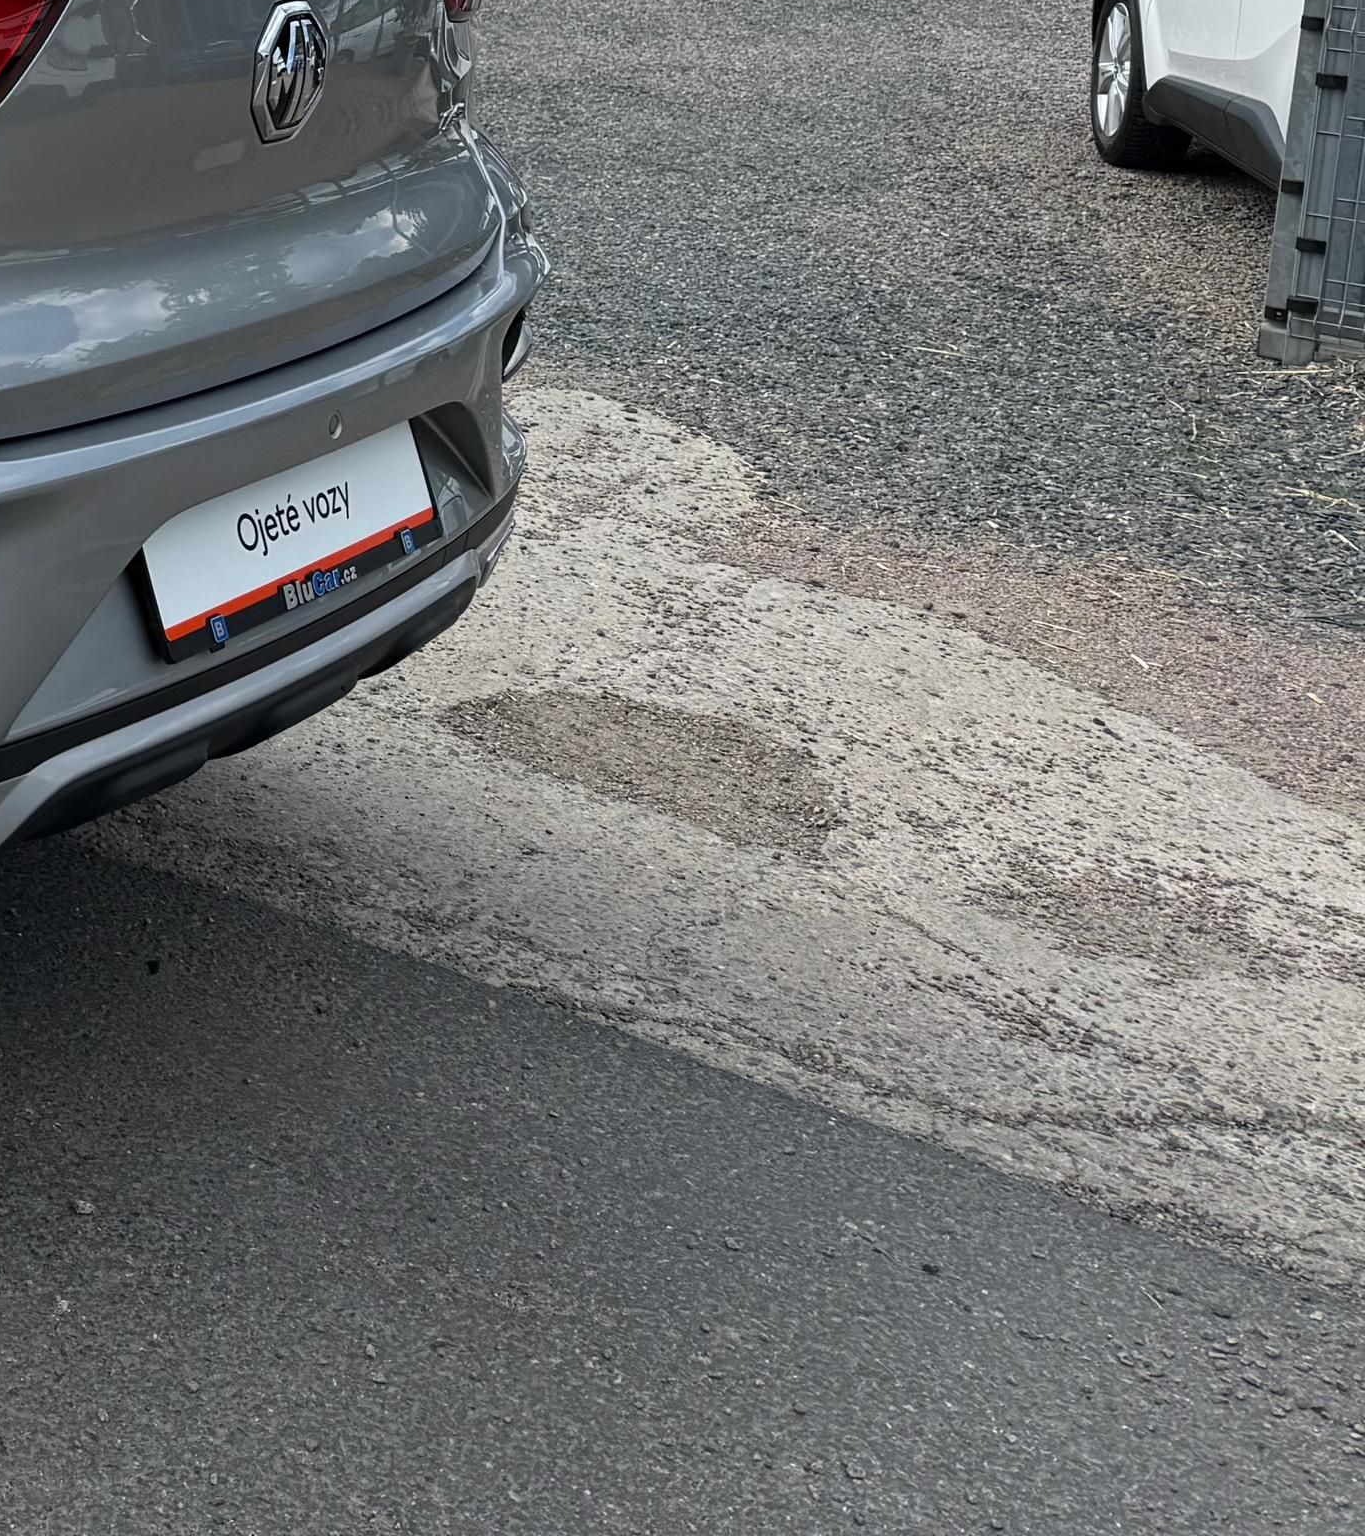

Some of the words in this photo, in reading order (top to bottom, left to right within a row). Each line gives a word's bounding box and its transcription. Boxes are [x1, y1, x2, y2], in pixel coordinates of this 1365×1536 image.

[237, 494, 301, 556] Ojeté
[302, 482, 349, 523] vozy
[283, 566, 358, 610] BluCar.cz
